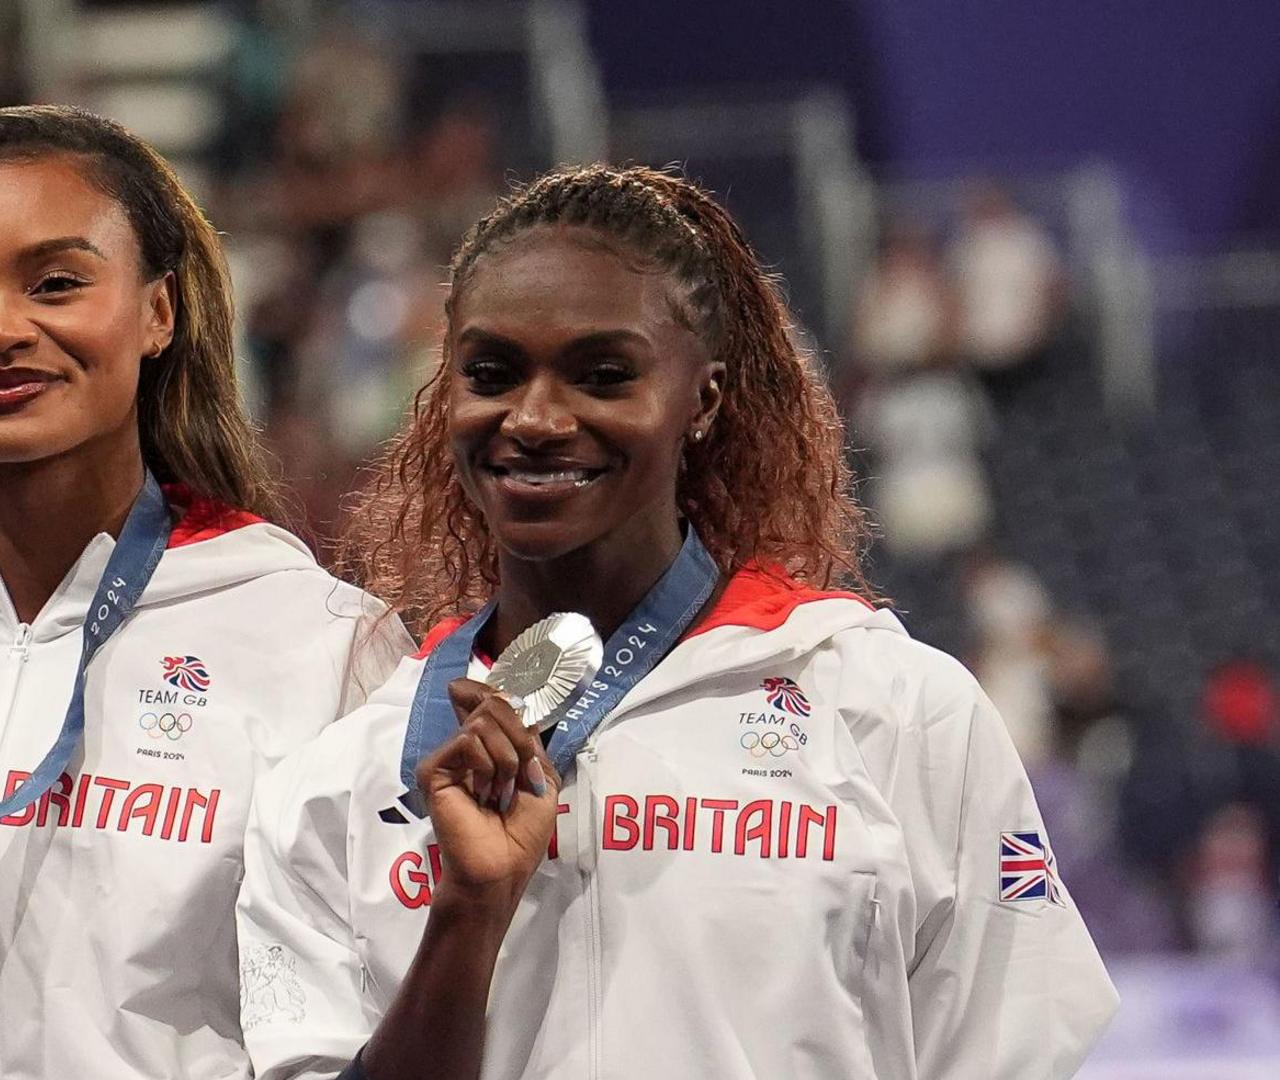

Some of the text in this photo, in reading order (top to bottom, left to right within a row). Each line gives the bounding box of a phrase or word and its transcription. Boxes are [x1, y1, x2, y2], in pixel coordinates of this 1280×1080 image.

[90, 576, 127, 636] 2024
[604, 623, 658, 678] 2024
[138, 689, 208, 708] TEAM GB
[739, 712, 809, 746] TEAM GB
[162, 751, 185, 761] 2024
[769, 768, 793, 778] 2024
[602, 794, 837, 862] BRITAIN
